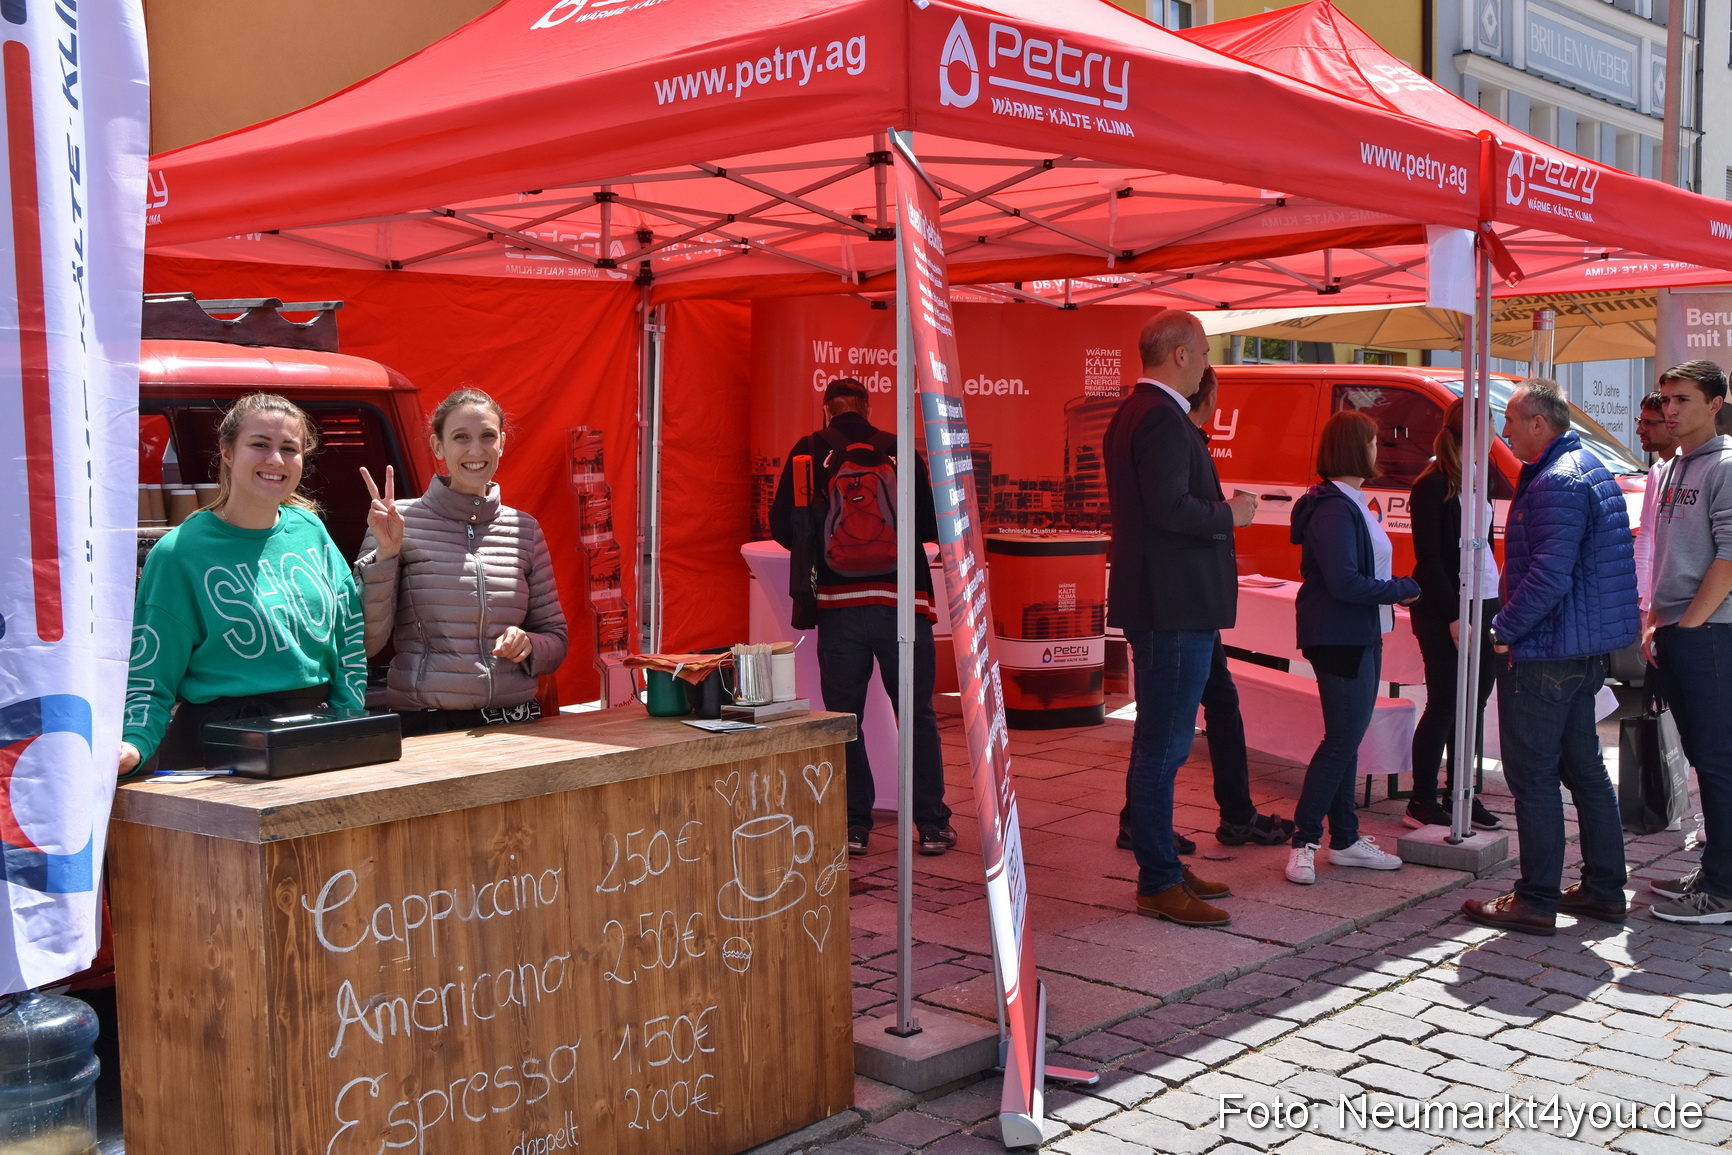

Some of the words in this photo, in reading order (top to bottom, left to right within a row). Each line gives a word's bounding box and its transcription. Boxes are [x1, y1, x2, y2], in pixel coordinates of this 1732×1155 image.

[55, 0, 79, 110] KLI
[653, 34, 867, 106] www.petry.ag
[988, 22, 1130, 110] Petry
[1531, 22, 1582, 70] BRILLEN
[1584, 44, 1630, 87] WEBER
[991, 97, 1044, 121] WÄRME
[1049, 108, 1092, 130] KÄLTE
[1095, 118, 1135, 137] KLIMA
[1360, 141, 1468, 195] www.petry.ag
[1528, 153, 1601, 205] Petry
[1527, 198, 1552, 214] WÄRME
[1552, 204, 1574, 218] KÄLTE
[1574, 209, 1595, 223] KLIMA
[813, 340, 842, 364] Wir
[848, 347, 897, 365] erwec
[1086, 348, 1121, 356] WÄRME
[1687, 329, 1720, 347] mit
[1085, 356, 1121, 367] KÄLTE
[1085, 367, 1121, 375] KLIMA
[963, 374, 1030, 396] eben.
[1592, 380, 1603, 396] 30
[1603, 384, 1620, 398] Jahre
[1583, 400, 1600, 417] Bang
[1600, 401, 1606, 414] &
[1607, 401, 1629, 415] Olufsen
[1053, 646, 1089, 656] Petry
[301, 853, 562, 961] Cappuccino
[328, 952, 572, 1059] Americano
[325, 1035, 582, 1155] Espresso
